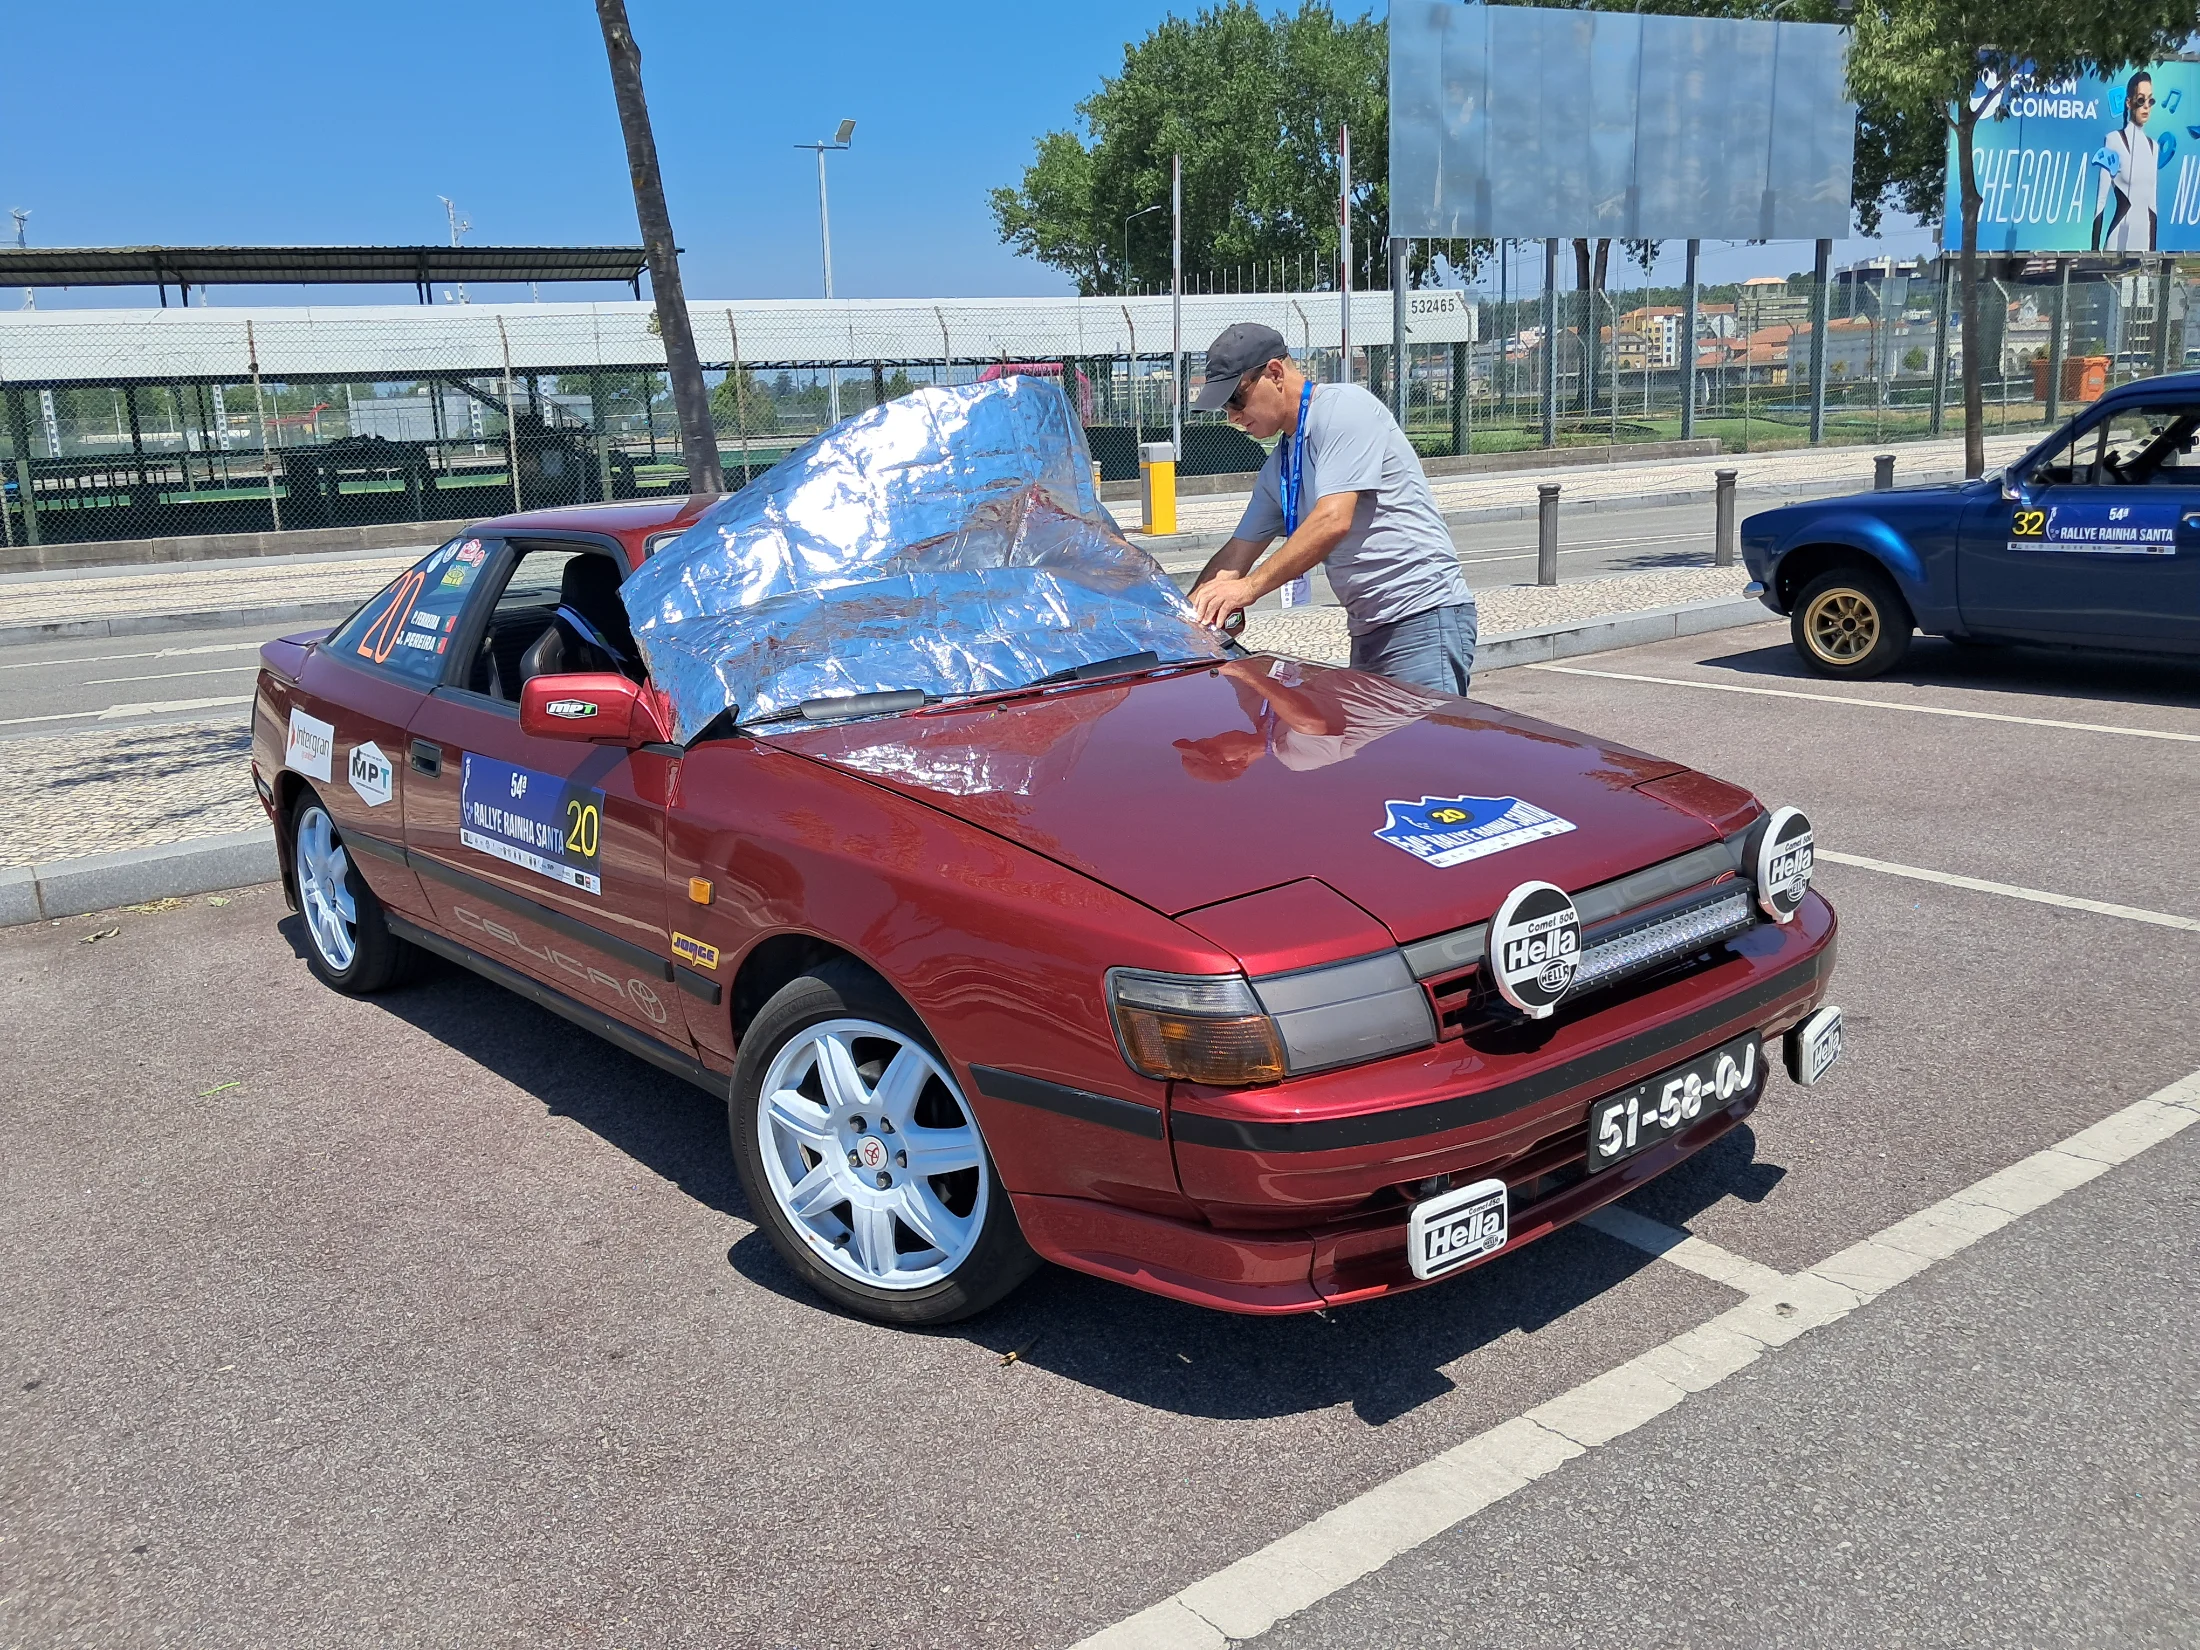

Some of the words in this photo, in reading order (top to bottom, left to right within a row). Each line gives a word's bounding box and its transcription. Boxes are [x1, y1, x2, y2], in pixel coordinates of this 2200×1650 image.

[2010, 73, 2077, 95] FOUM
[2010, 98, 2098, 119] COIMBRA
[2066, 152, 2088, 223] A
[1411, 298, 1455, 314] 532465
[2012, 511, 2046, 536] 32
[2108, 507, 2131, 521] 54ª
[2060, 527, 2096, 541] RALLYE
[2099, 528, 2137, 541] RAINHA
[2139, 529, 2174, 542] SANTA
[357, 569, 426, 664] 20
[403, 631, 437, 652] PEREIRA
[352, 756, 390, 789] MPT
[510, 772, 528, 799] 54ª
[473, 801, 503, 834] RALLYE
[503, 811, 535, 845] RAINHA
[535, 822, 565, 856] SANTA
[565, 799, 599, 857] 20
[1419, 828, 1483, 850] RALLYE
[1469, 817, 1523, 838] RAINHA
[1502, 800, 1561, 827] SANTA
[1431, 809, 1467, 824] 20
[1770, 848, 1812, 884] Hella
[1528, 916, 1557, 933] Comet
[1559, 911, 1574, 924] 500
[454, 905, 627, 998] CELICA
[673, 936, 715, 963] JORGE
[1508, 930, 1576, 971] Hella
[1541, 965, 1570, 983] HELLA
[1813, 1030, 1840, 1071] Hella
[1428, 1212, 1500, 1259] Hella
